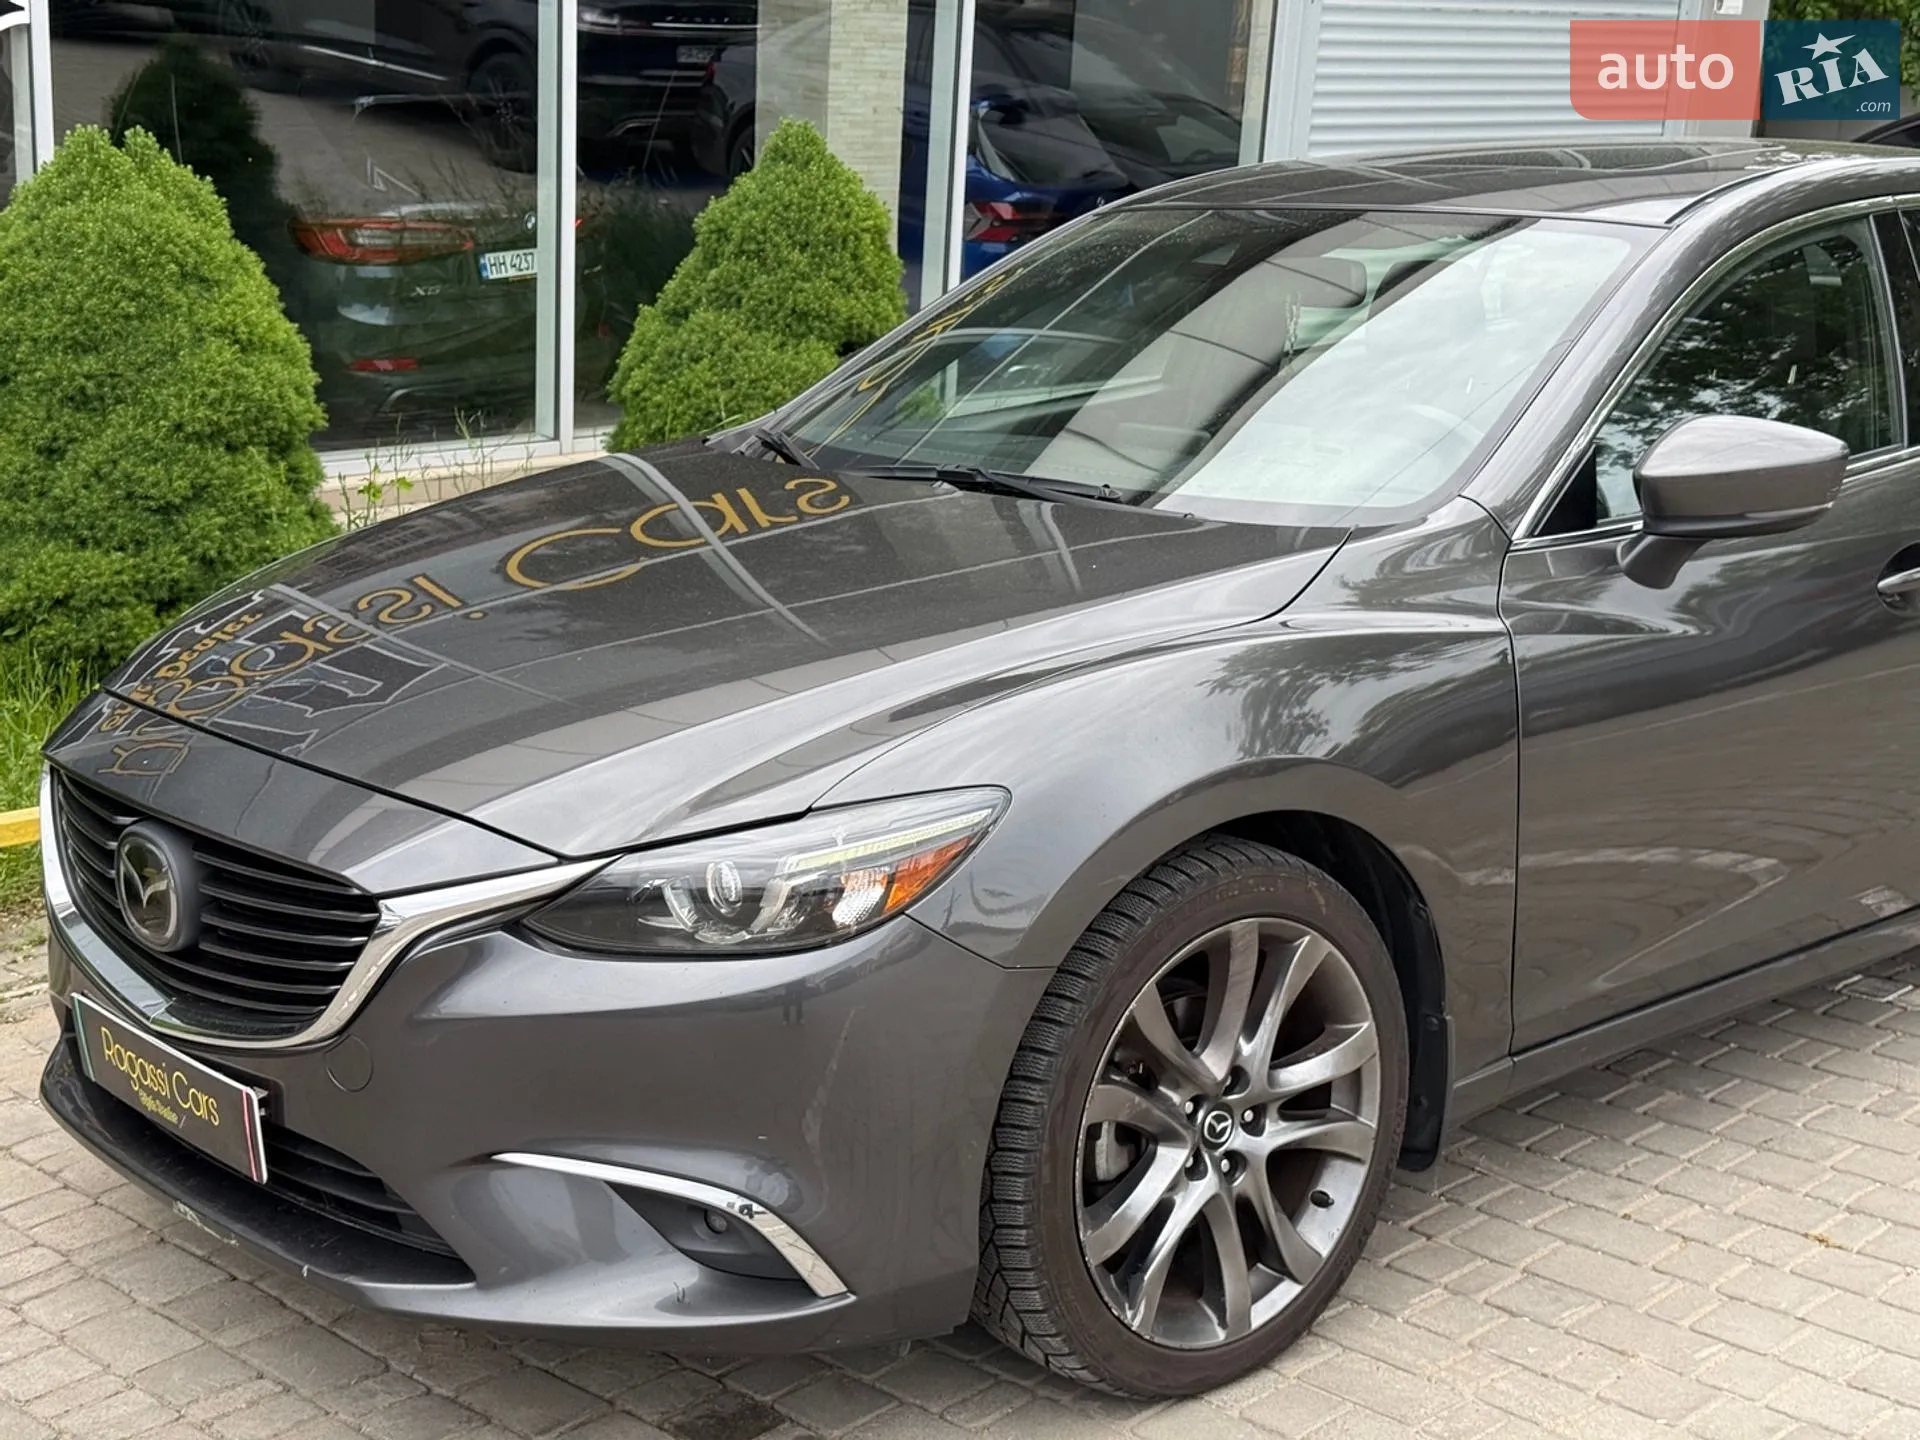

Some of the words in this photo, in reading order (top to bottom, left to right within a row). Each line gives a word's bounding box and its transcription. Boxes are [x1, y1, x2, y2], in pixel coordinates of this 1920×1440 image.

[509, 252, 535, 272] 4237
[101, 1026, 171, 1099] Ragassi
[172, 1071, 219, 1125] Cars
